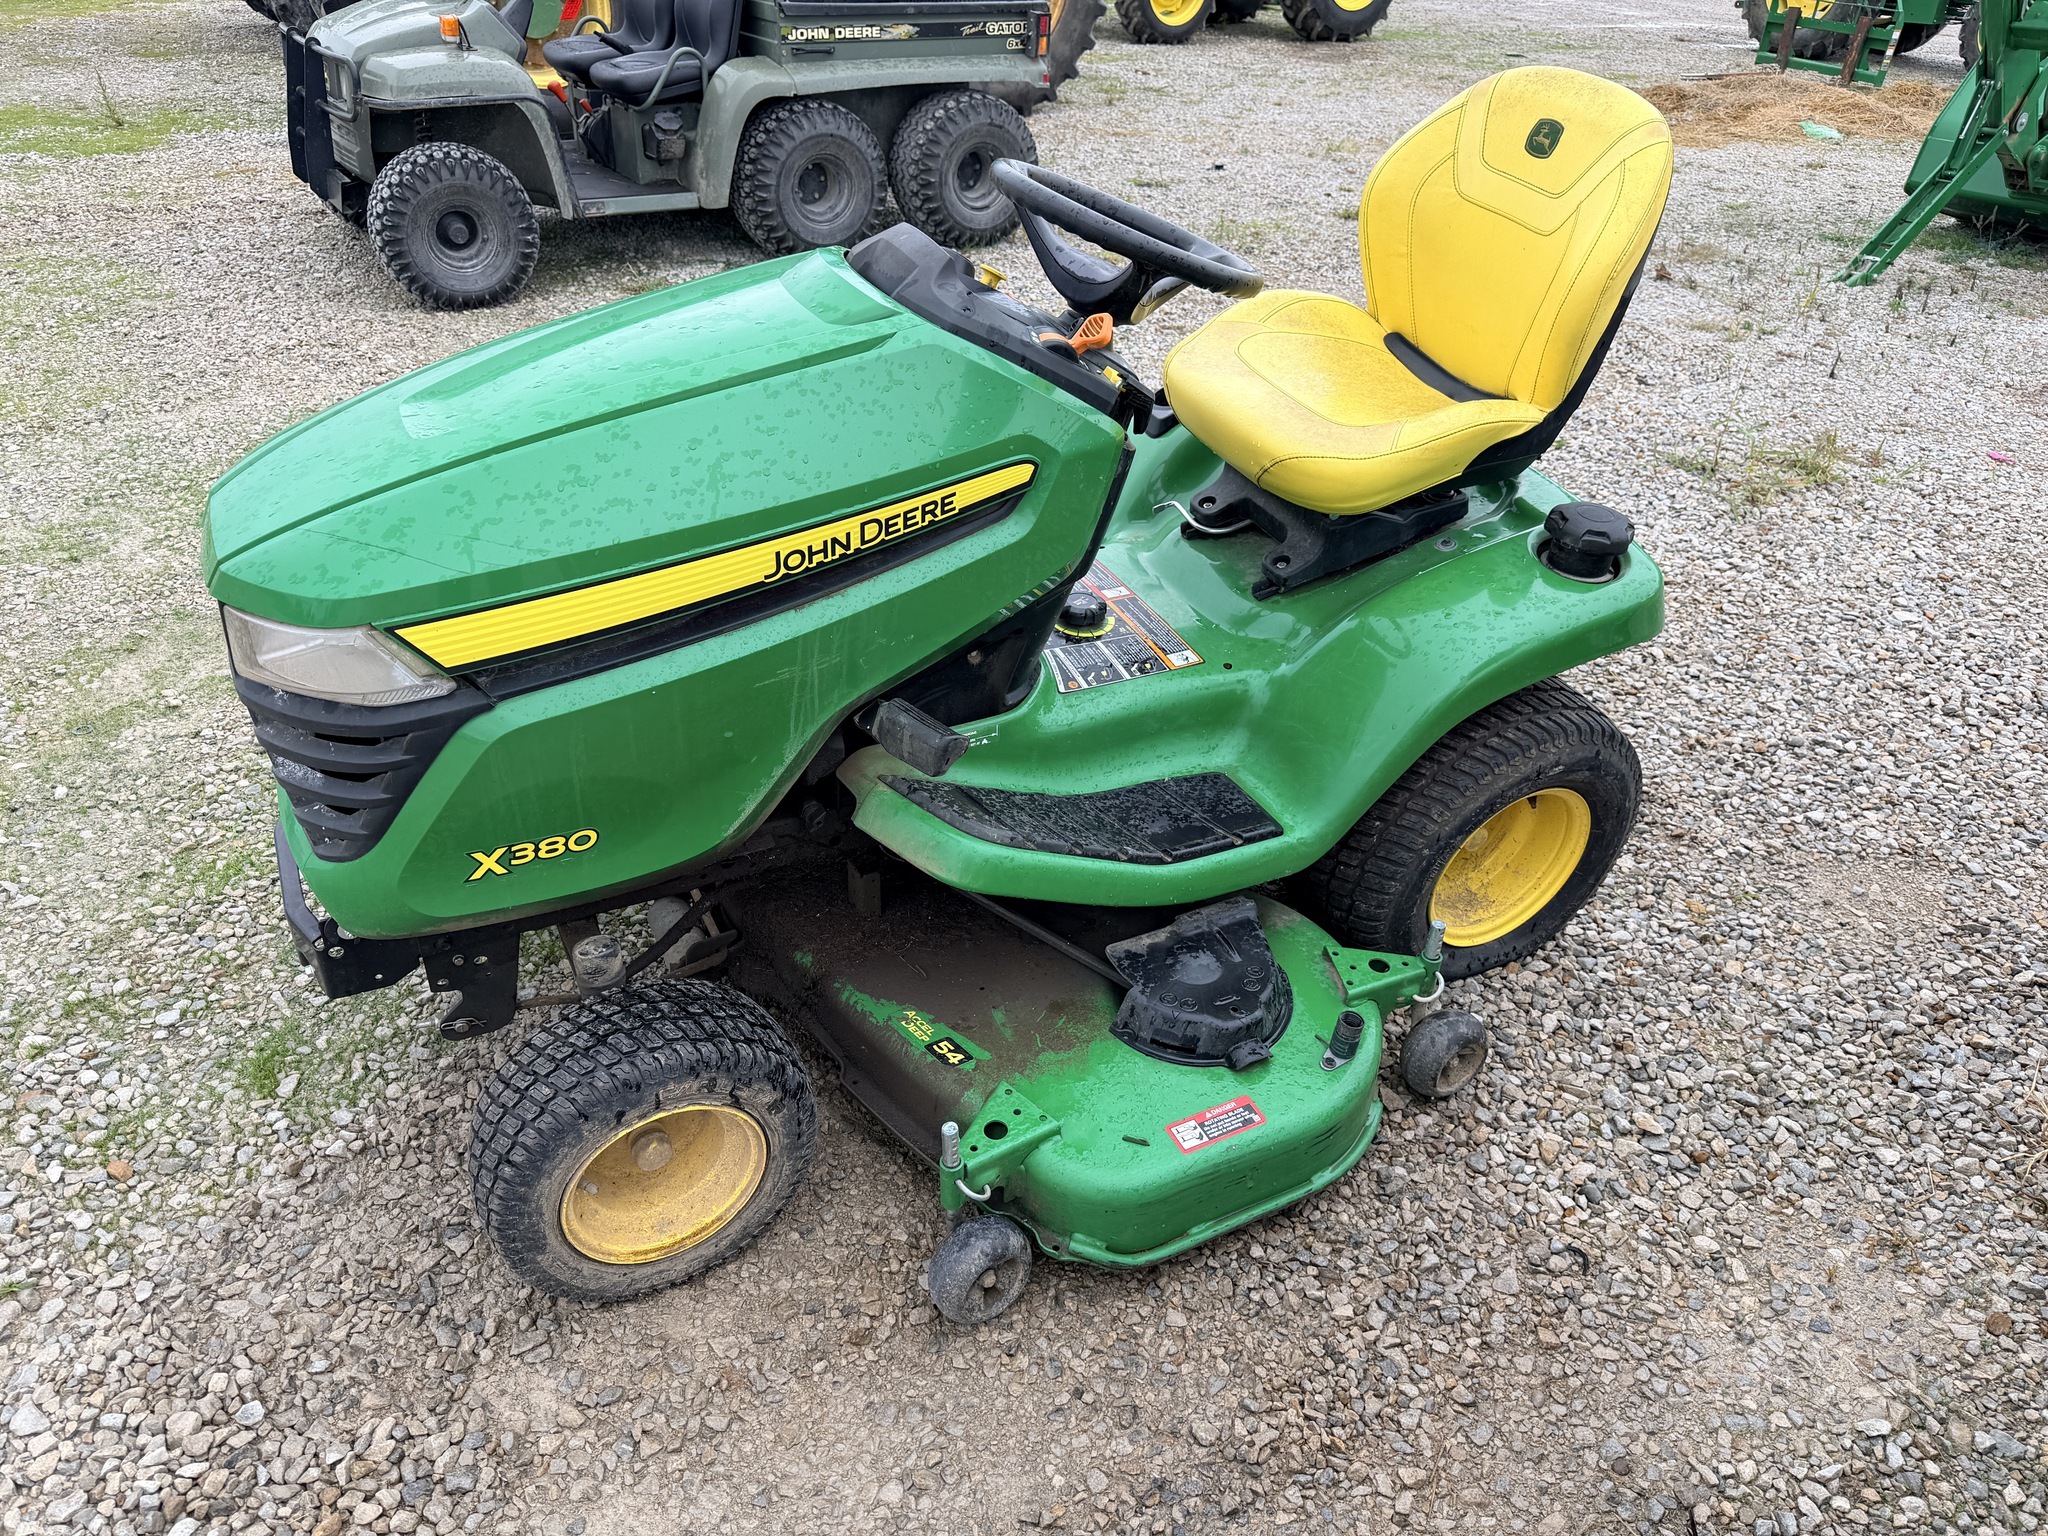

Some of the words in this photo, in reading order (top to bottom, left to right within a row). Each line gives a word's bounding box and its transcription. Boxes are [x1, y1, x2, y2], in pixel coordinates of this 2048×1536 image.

[787, 28, 830, 40] JOHN
[834, 26, 881, 39] DEERE
[960, 22, 986, 37] Trail
[763, 531, 852, 581] JOHN
[859, 491, 958, 547] DEERE
[463, 827, 600, 883] X380
[903, 1011, 935, 1036] ACCEL
[932, 1040, 966, 1065] 54
[1210, 1102, 1237, 1115] DANGER
